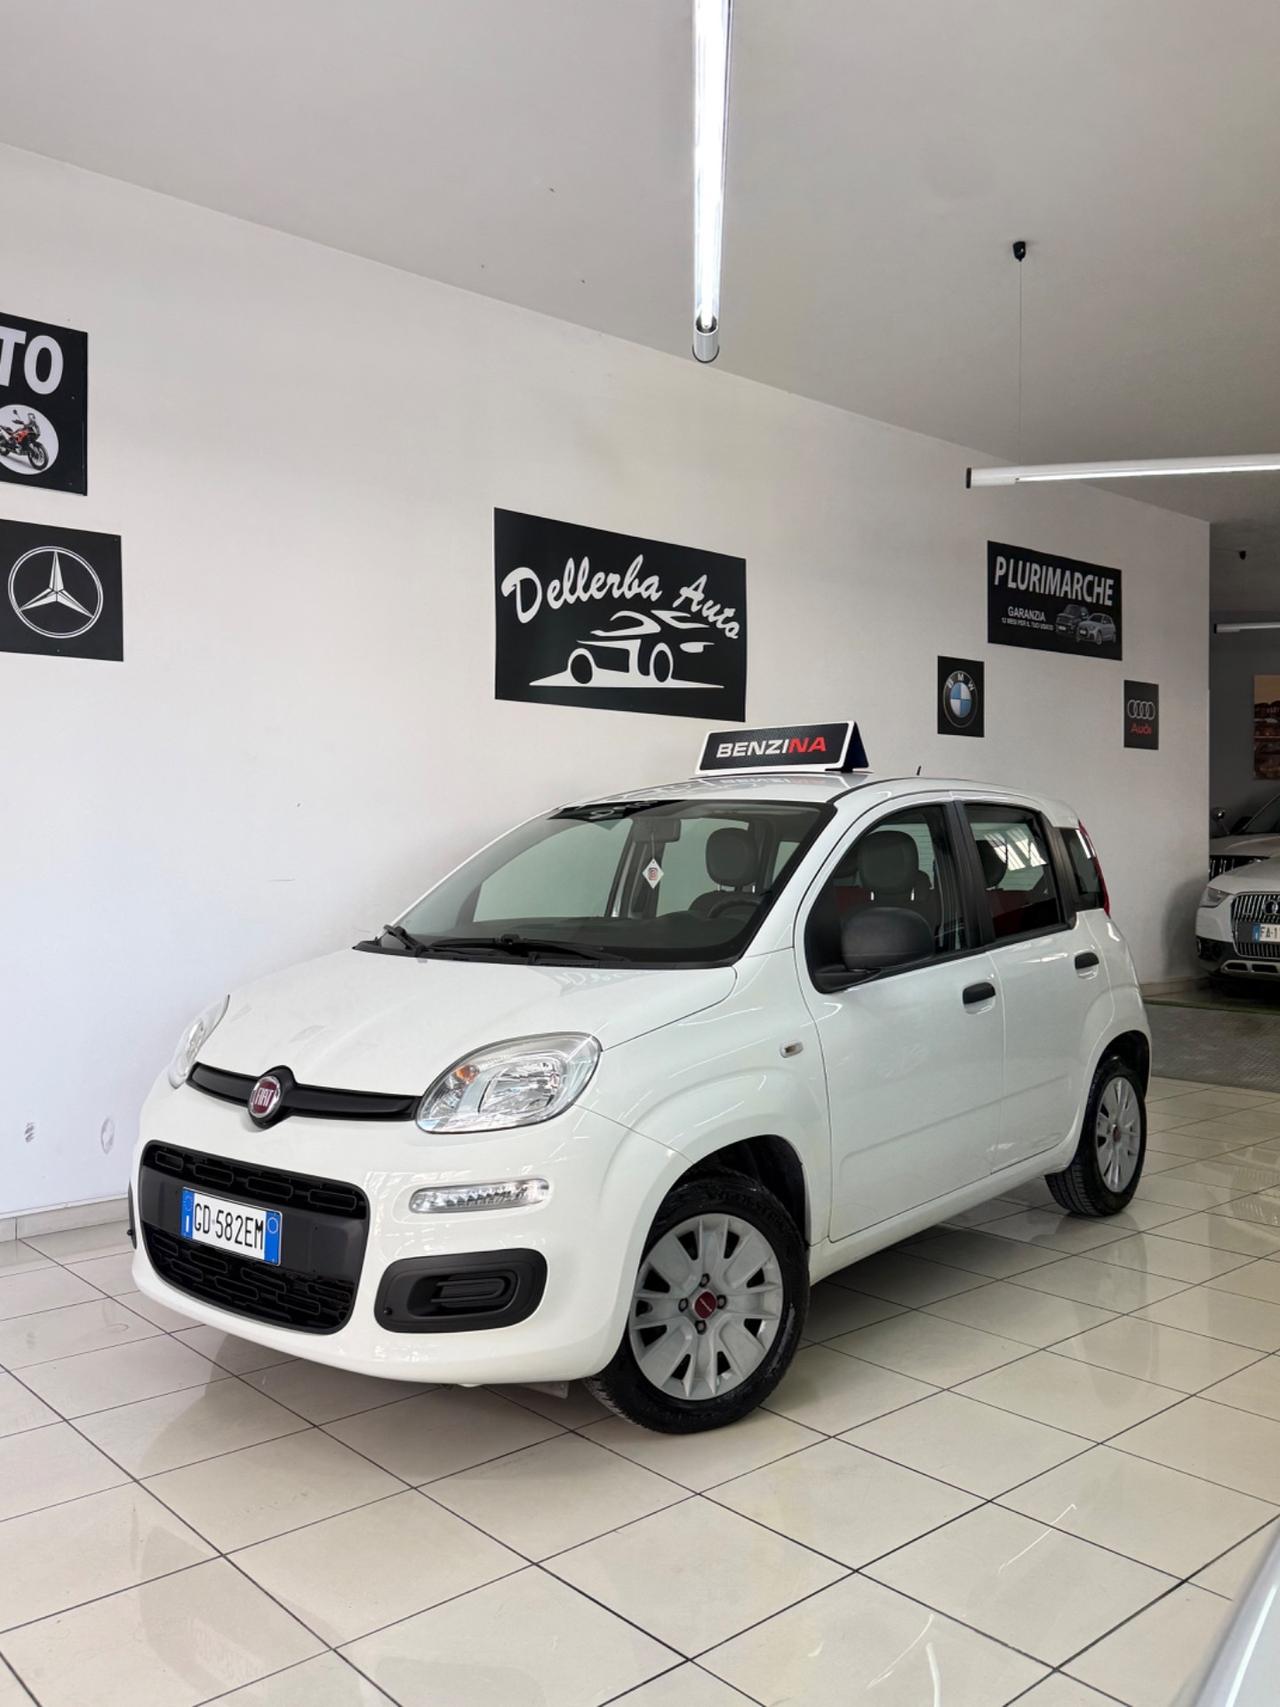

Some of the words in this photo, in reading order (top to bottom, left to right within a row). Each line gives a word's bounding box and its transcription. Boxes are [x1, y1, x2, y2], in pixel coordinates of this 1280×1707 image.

[994, 555, 1114, 606] PLURIMARCHE
[501, 554, 663, 623] Dellerba
[672, 574, 740, 639] Auto
[1008, 606, 1046, 622] GARANZIA
[945, 673, 975, 691] BMW
[1130, 722, 1153, 735] Audi
[716, 737, 827, 758] BENZINA
[253, 1087, 274, 1107] FIAT
